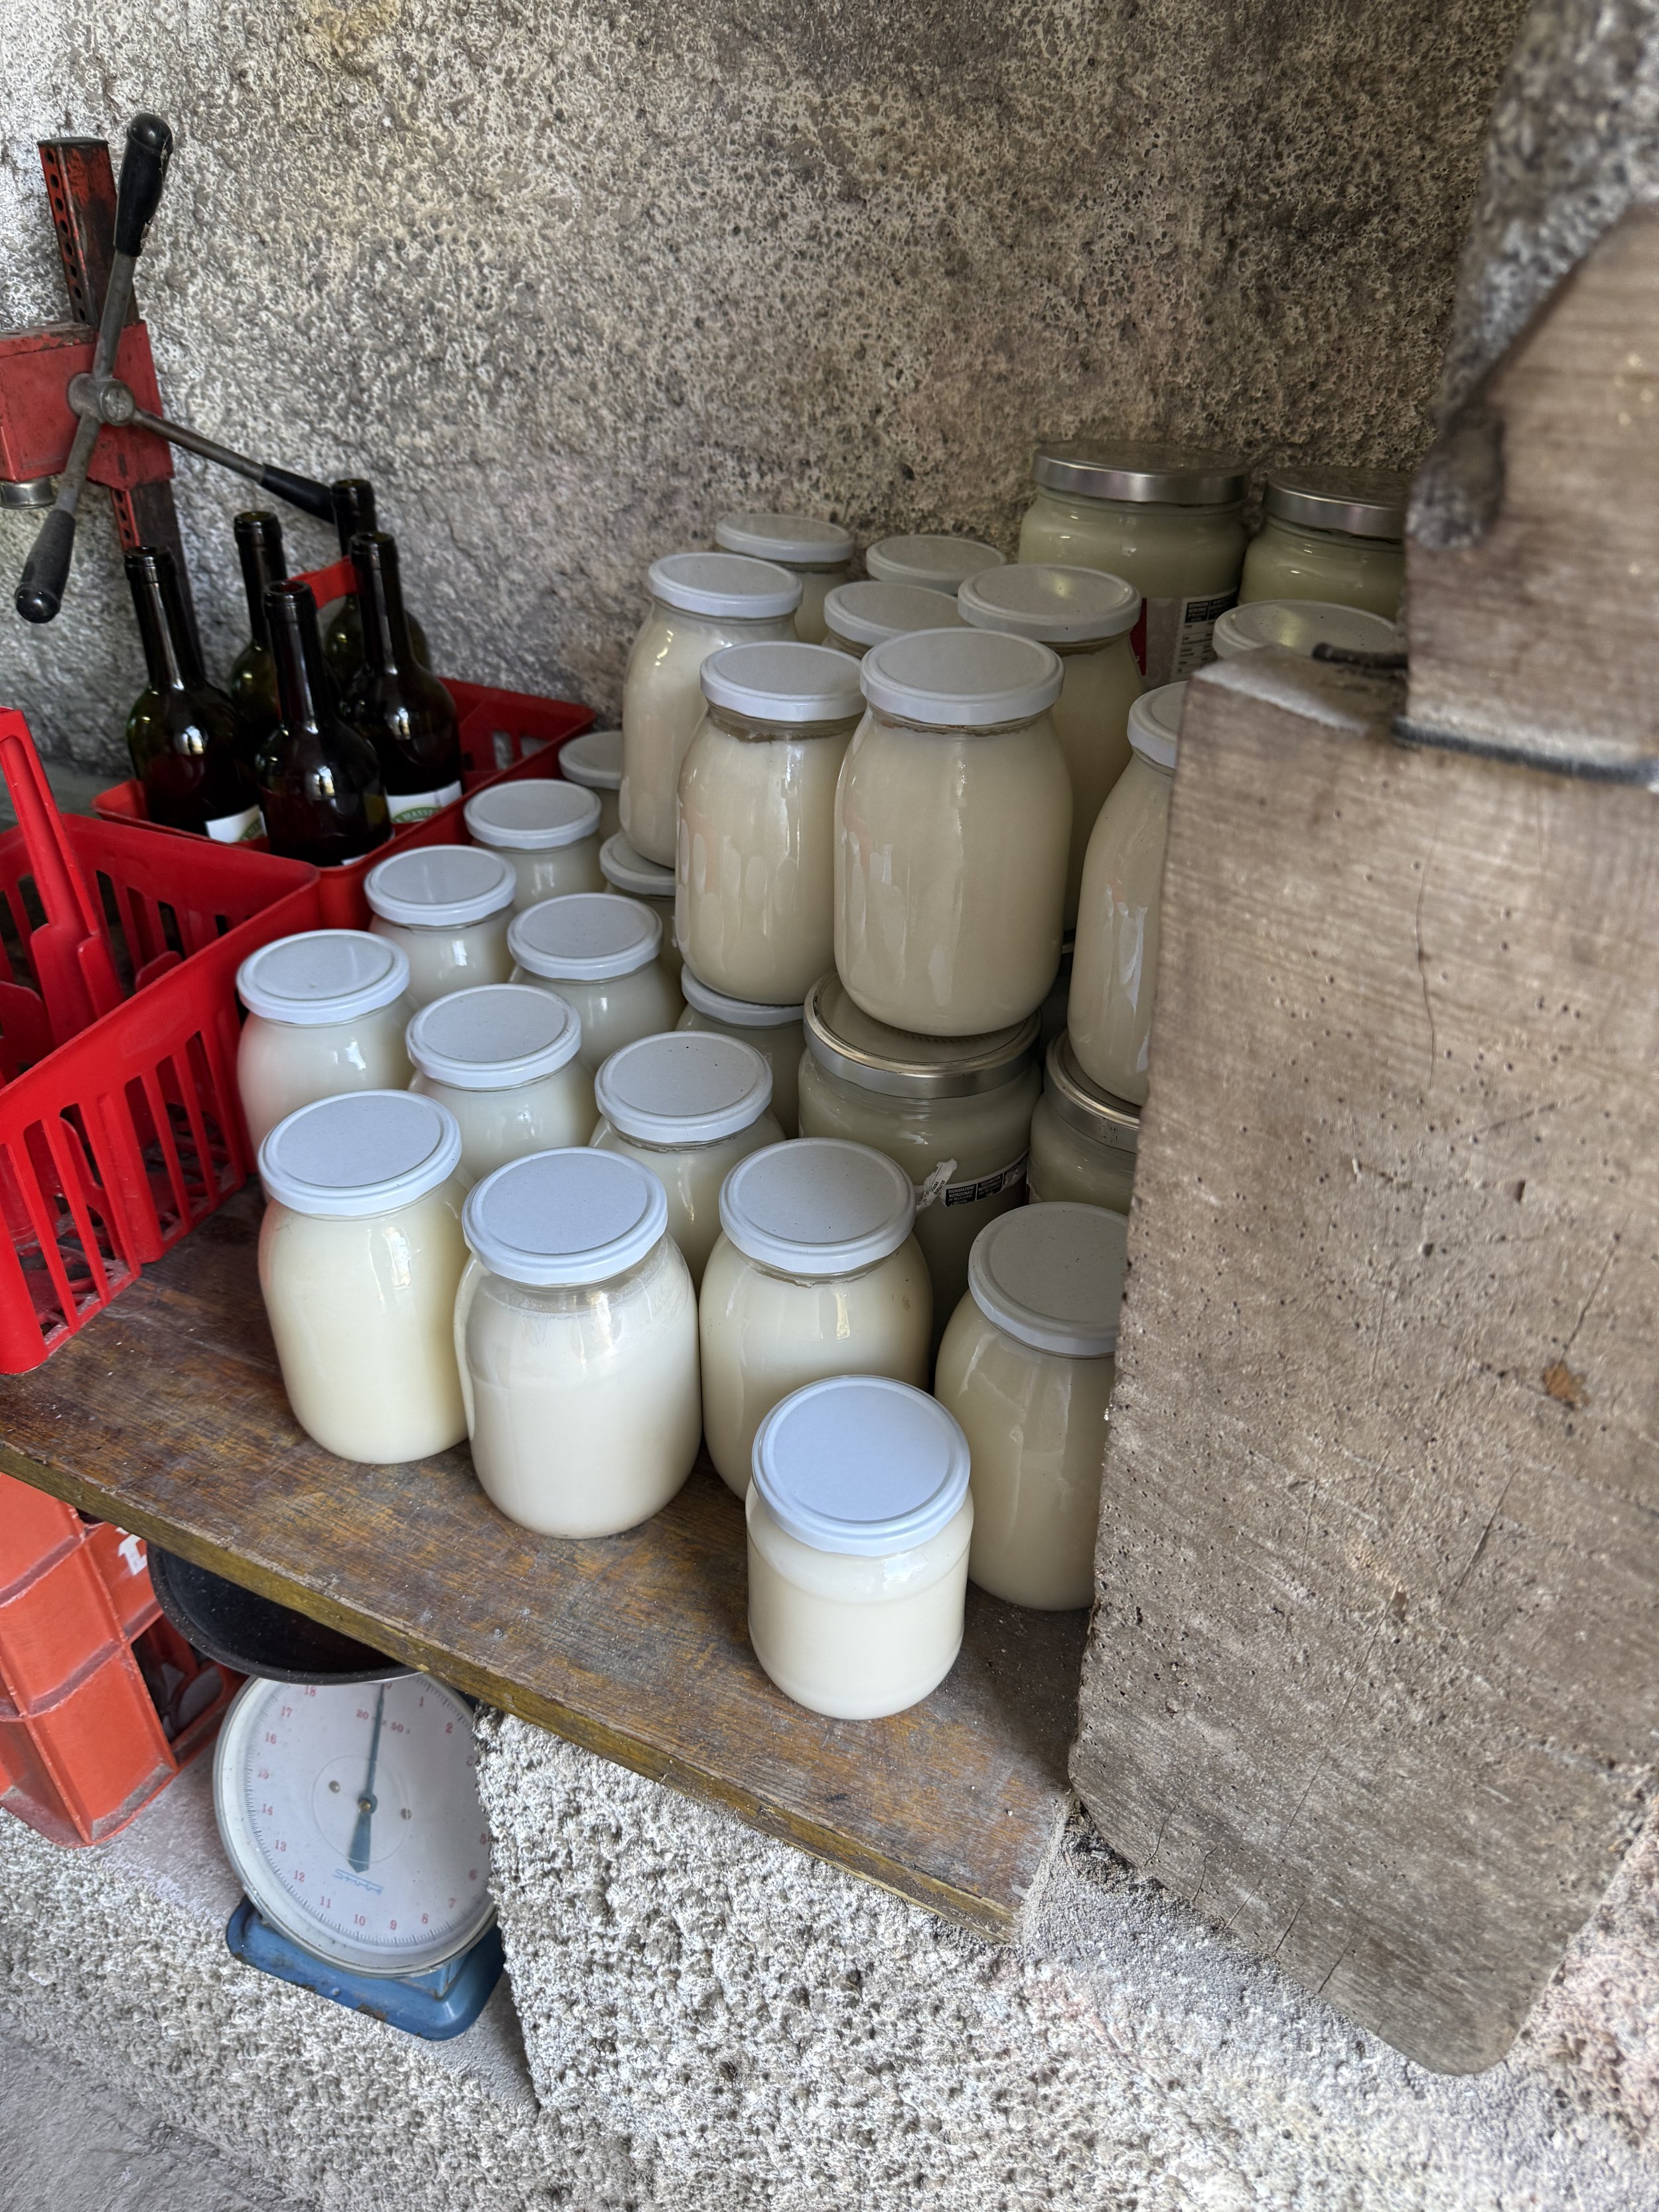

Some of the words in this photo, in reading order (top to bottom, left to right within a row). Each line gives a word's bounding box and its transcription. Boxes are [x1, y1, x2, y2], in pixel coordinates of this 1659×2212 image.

[305, 1685, 317, 1697] 18
[419, 1696, 424, 1707] 1
[281, 1706, 293, 1718] 17
[356, 1709, 369, 1720] 20
[445, 1722, 453, 1734] 2
[265, 1732, 277, 1744] 16
[262, 1803, 273, 1815] 14
[275, 1839, 287, 1852] 13
[294, 1870, 305, 1882] 12
[320, 1896, 330, 1908] 11
[354, 1914, 366, 1926] 10
[422, 1913, 429, 1924] 8
[390, 1919, 397, 1931] 9
